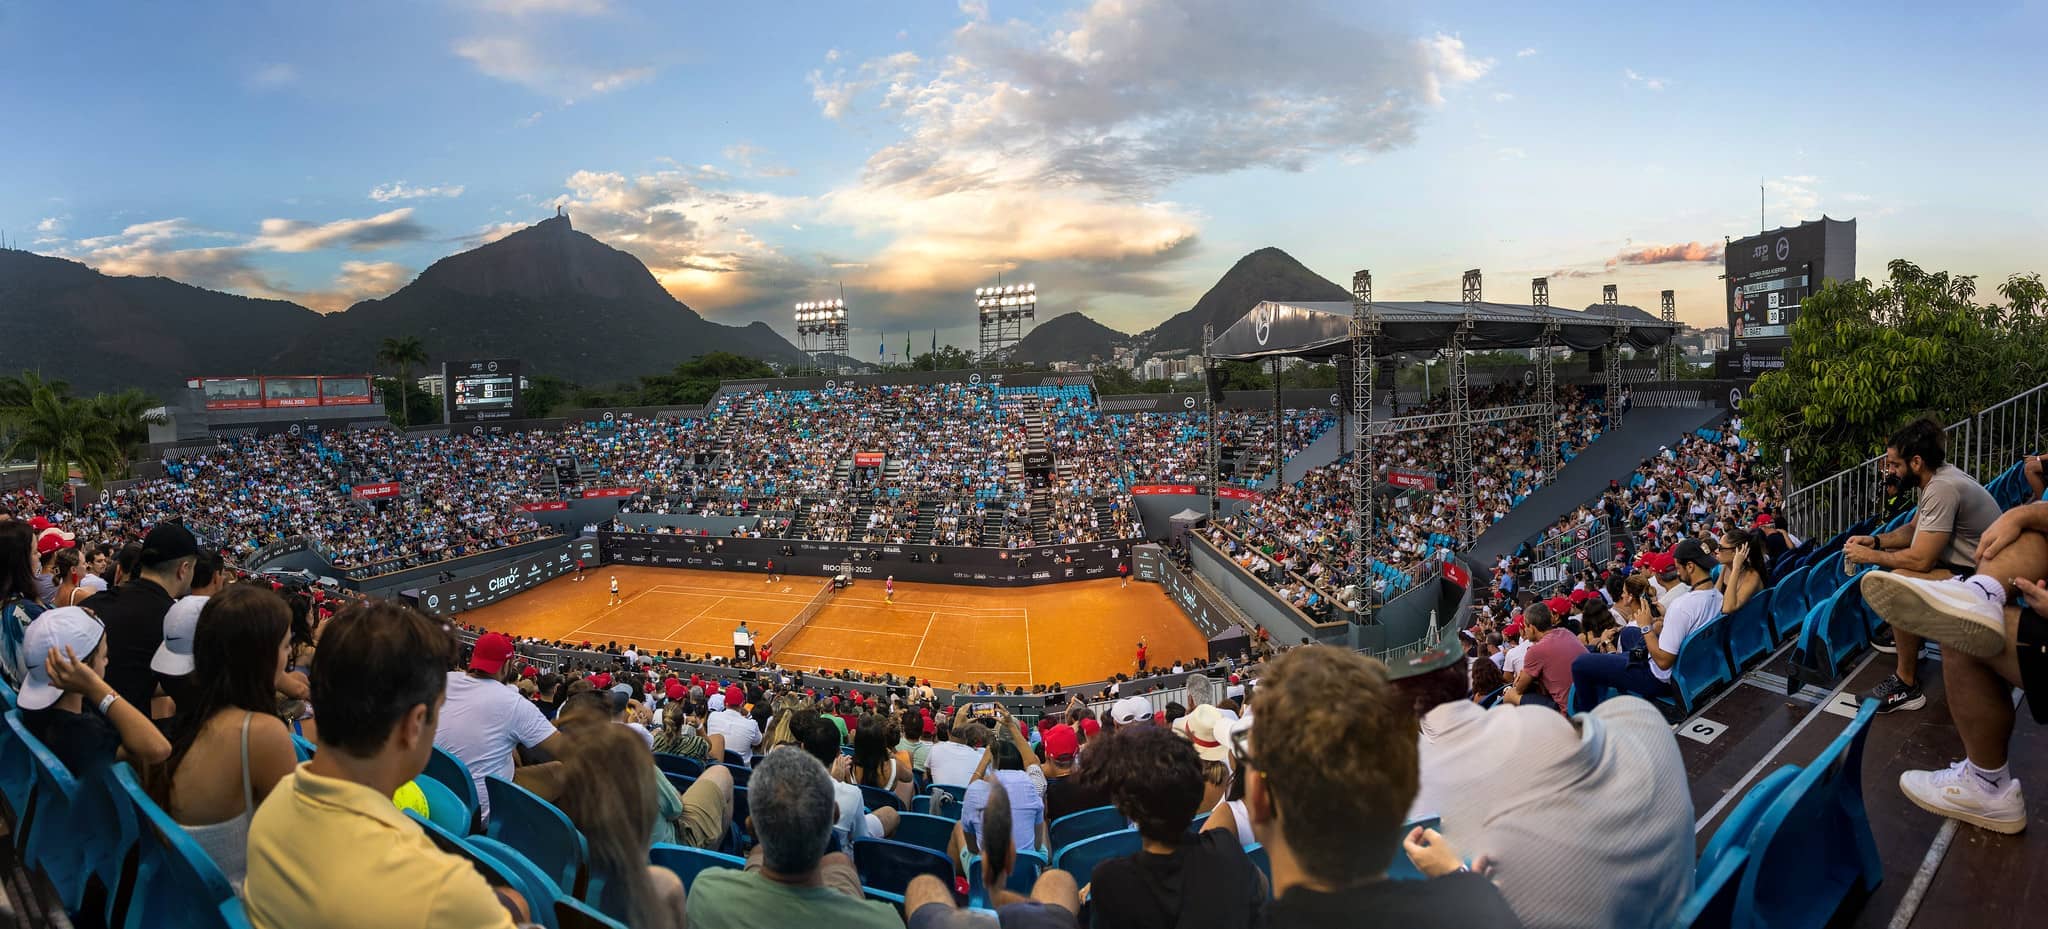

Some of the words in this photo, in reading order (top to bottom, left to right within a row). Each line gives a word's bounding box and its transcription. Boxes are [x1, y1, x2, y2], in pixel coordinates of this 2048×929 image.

[362, 488, 378, 496] FINAL
[488, 571, 518, 591] Claro
[1888, 691, 1908, 705] FILA
[1692, 723, 1714, 736] S
